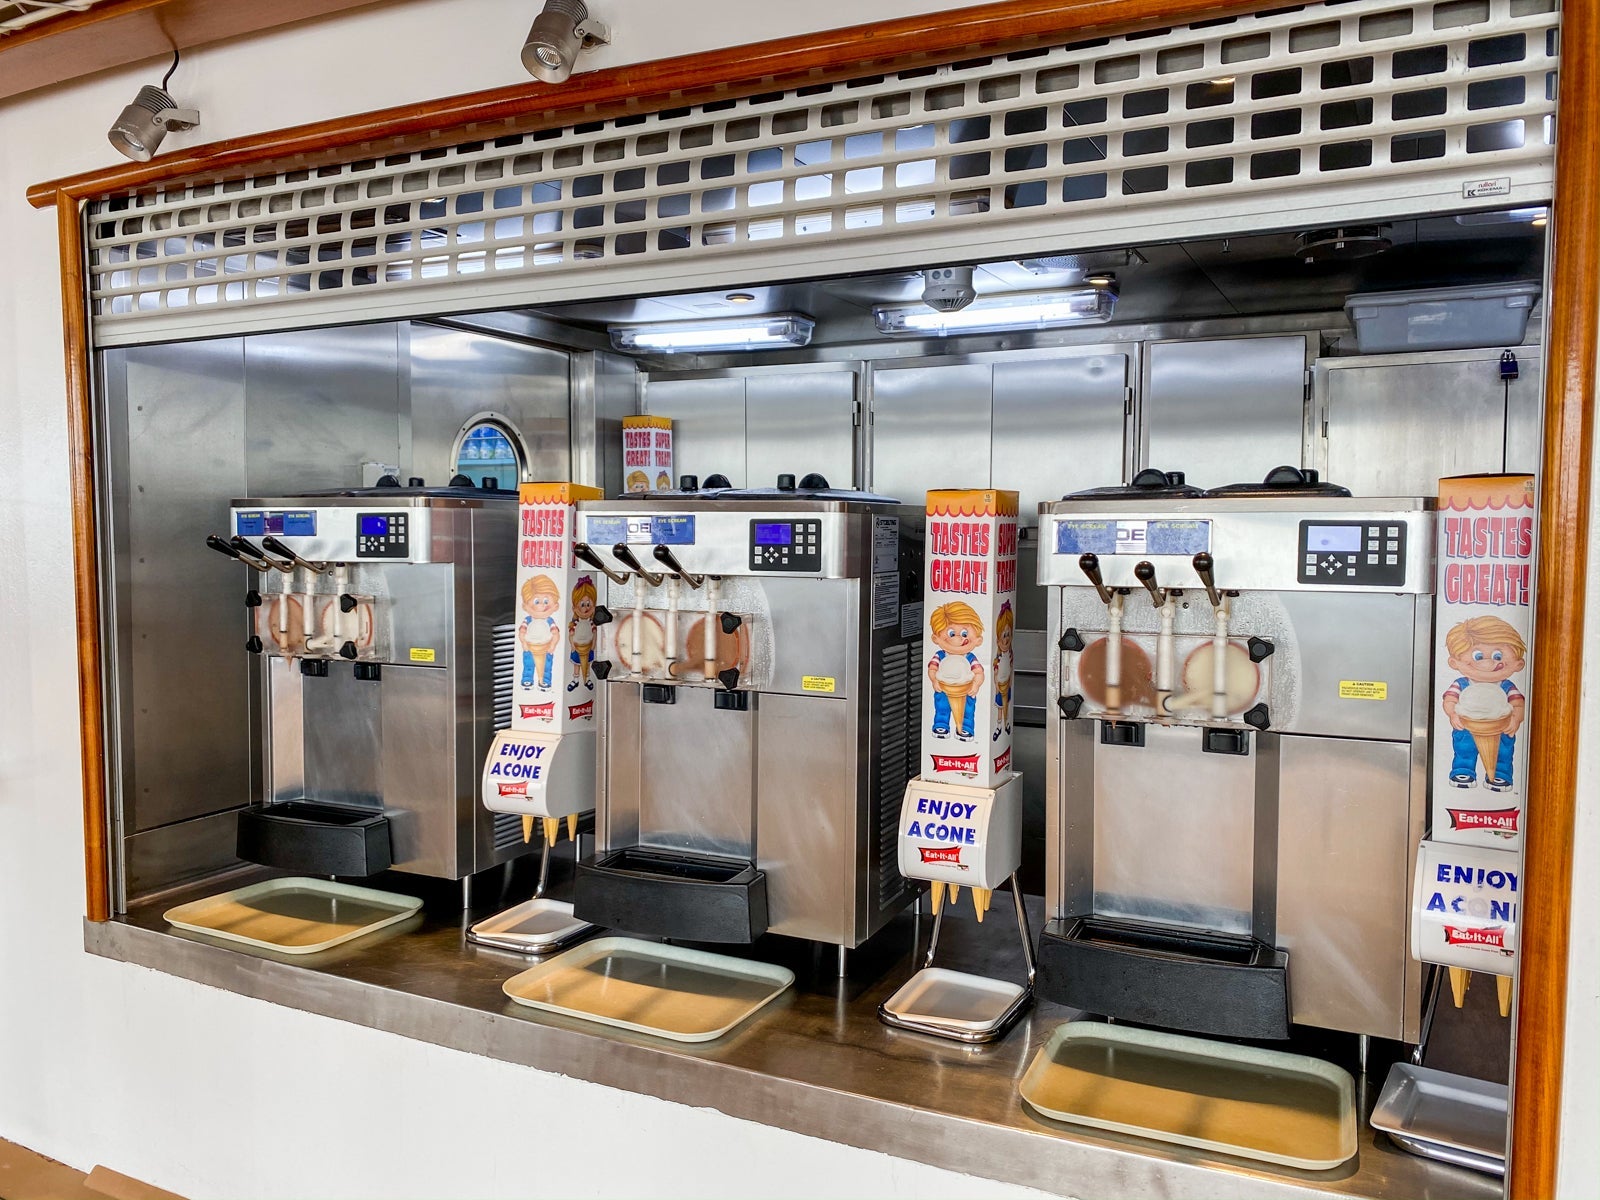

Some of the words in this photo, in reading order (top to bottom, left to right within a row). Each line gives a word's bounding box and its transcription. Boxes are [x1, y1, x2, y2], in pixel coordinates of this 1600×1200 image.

[625, 431, 651, 449] TASTES
[655, 432, 670, 449] SUPER
[625, 449, 651, 467] GREAT!
[522, 509, 565, 537] TASTES
[931, 522, 990, 556] TASTES
[1444, 516, 1533, 558] TASTES
[521, 540, 563, 568] GREAT!
[930, 558, 988, 594] GREAT!
[1444, 563, 1530, 606] GREAT!
[500, 743, 546, 761] ENJOY
[490, 762, 501, 775] A
[503, 762, 541, 779] CONE
[917, 798, 977, 820] ENJOY
[907, 820, 922, 838] A
[924, 822, 976, 845] CONE
[1426, 891, 1447, 912] A
